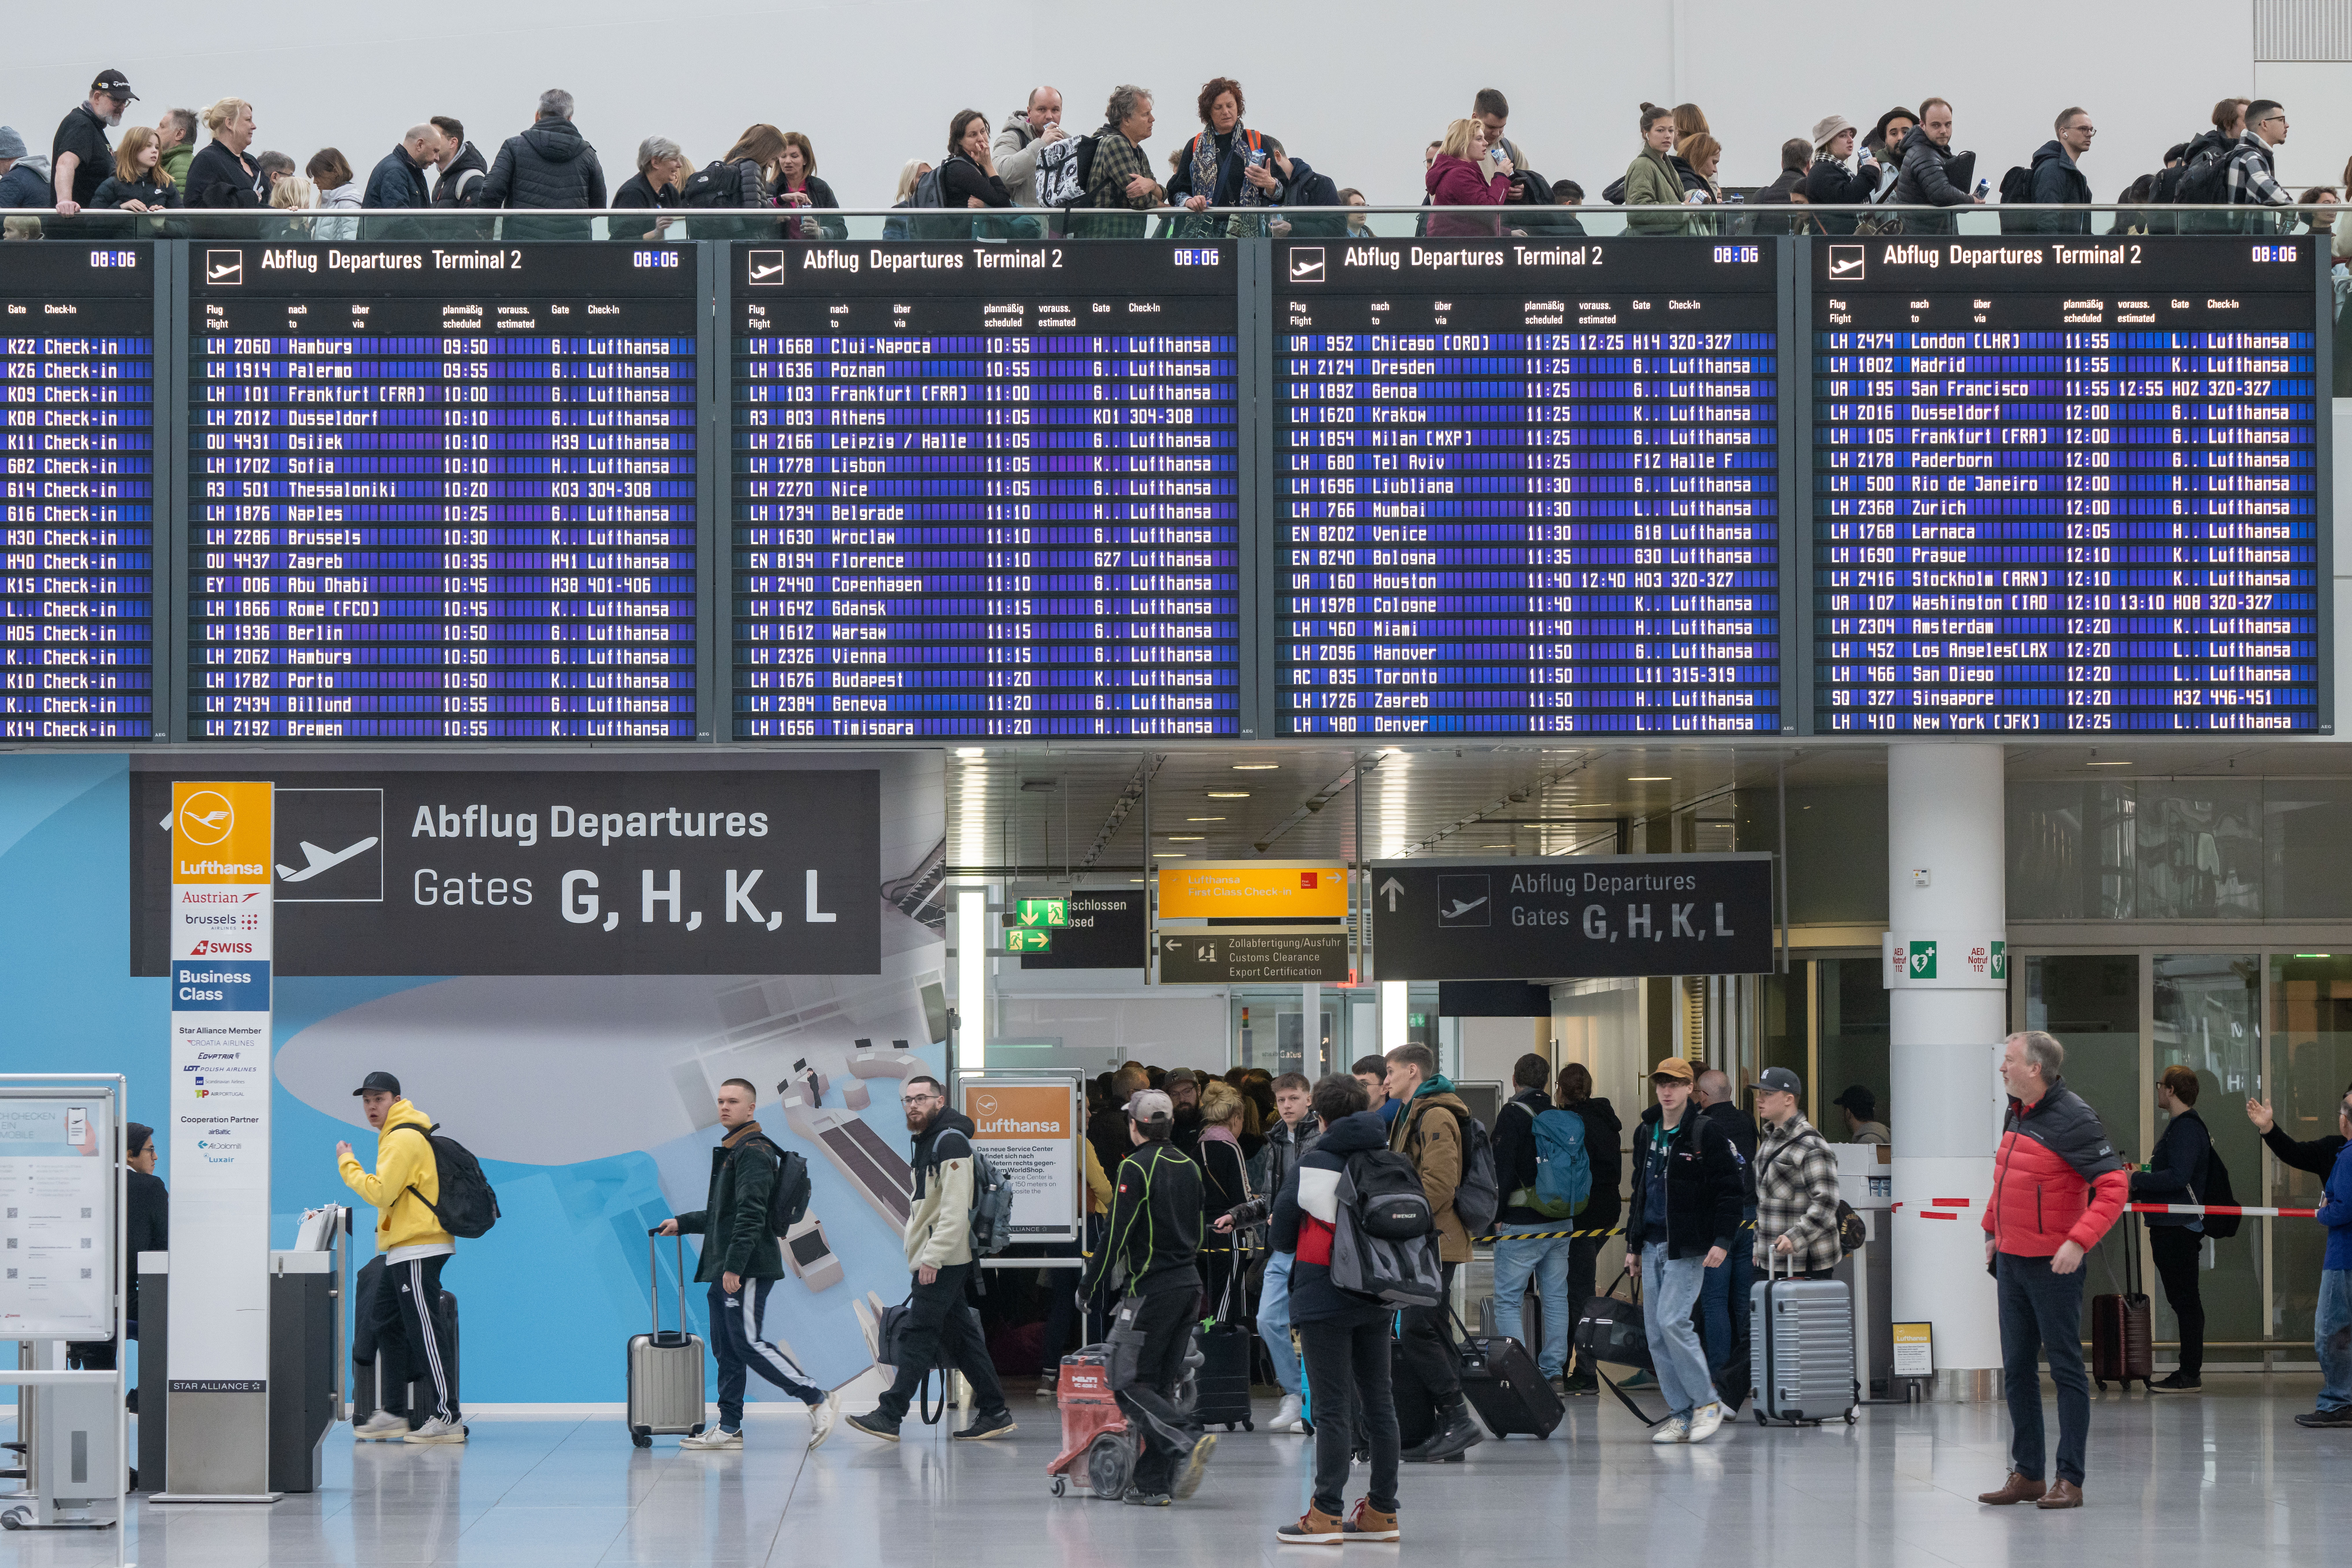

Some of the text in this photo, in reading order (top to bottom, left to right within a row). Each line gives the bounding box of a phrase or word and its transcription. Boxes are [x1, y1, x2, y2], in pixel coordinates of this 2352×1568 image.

[91, 252, 135, 267] 08:06
[262, 250, 677, 272] Abflug Departures Terminal 2 08:06
[804, 249, 1218, 272] Abflug Departures Terminal 2 08:06
[1345, 246, 1758, 270] Abflug Departures Terminal 2 08:06
[1884, 245, 2296, 268] Abflug Departures Terminal 2 08:06
[9, 305, 76, 313] Gate Check-In
[207, 305, 222, 316] Flug
[289, 305, 306, 314] nach
[352, 305, 369, 314] über
[443, 305, 482, 316] planmäßig
[552, 305, 569, 314] Gate
[588, 305, 619, 314] Check-In
[9, 339, 116, 354] K22 Check-in
[751, 552, 1210, 568] EN 8194 Florence 11:10 G27 Lufthansa
[207, 578, 650, 592] EY 006 Abu Dhabi 10:45 H38 401-406
[1294, 668, 1734, 684] AC 835 Toronto 11:50 L11 315-319
[1833, 690, 2270, 705] SQ 327 Singapore 12:20 H32 446-451
[7, 722, 115, 736] K14 Check-in
[412, 805, 768, 846] Abflug Departures
[181, 860, 263, 875] Lufthansa
[1189, 875, 1240, 884] Lufthansa
[1511, 873, 1695, 896] Abflug Departures
[182, 891, 238, 902] Austrian
[1214, 887, 1242, 896] Class
[1245, 887, 1291, 896] Check-in
[415, 869, 836, 931] Gates G, H, K, L
[1067, 899, 1127, 910] schlossen
[186, 915, 236, 924] brussels
[1512, 903, 1734, 942] Gates G, H, K, L
[211, 943, 252, 953] SWISS
[1229, 938, 1340, 949] Zollabfertigung/Ausfuhr
[1230, 953, 1319, 962] Customs Clearance
[180, 970, 251, 983] Business
[1230, 967, 1321, 978] Export Certification
[180, 987, 223, 1000] Class
[195, 1090, 209, 1098] TAP
[977, 1118, 1059, 1132] Lufthansa
